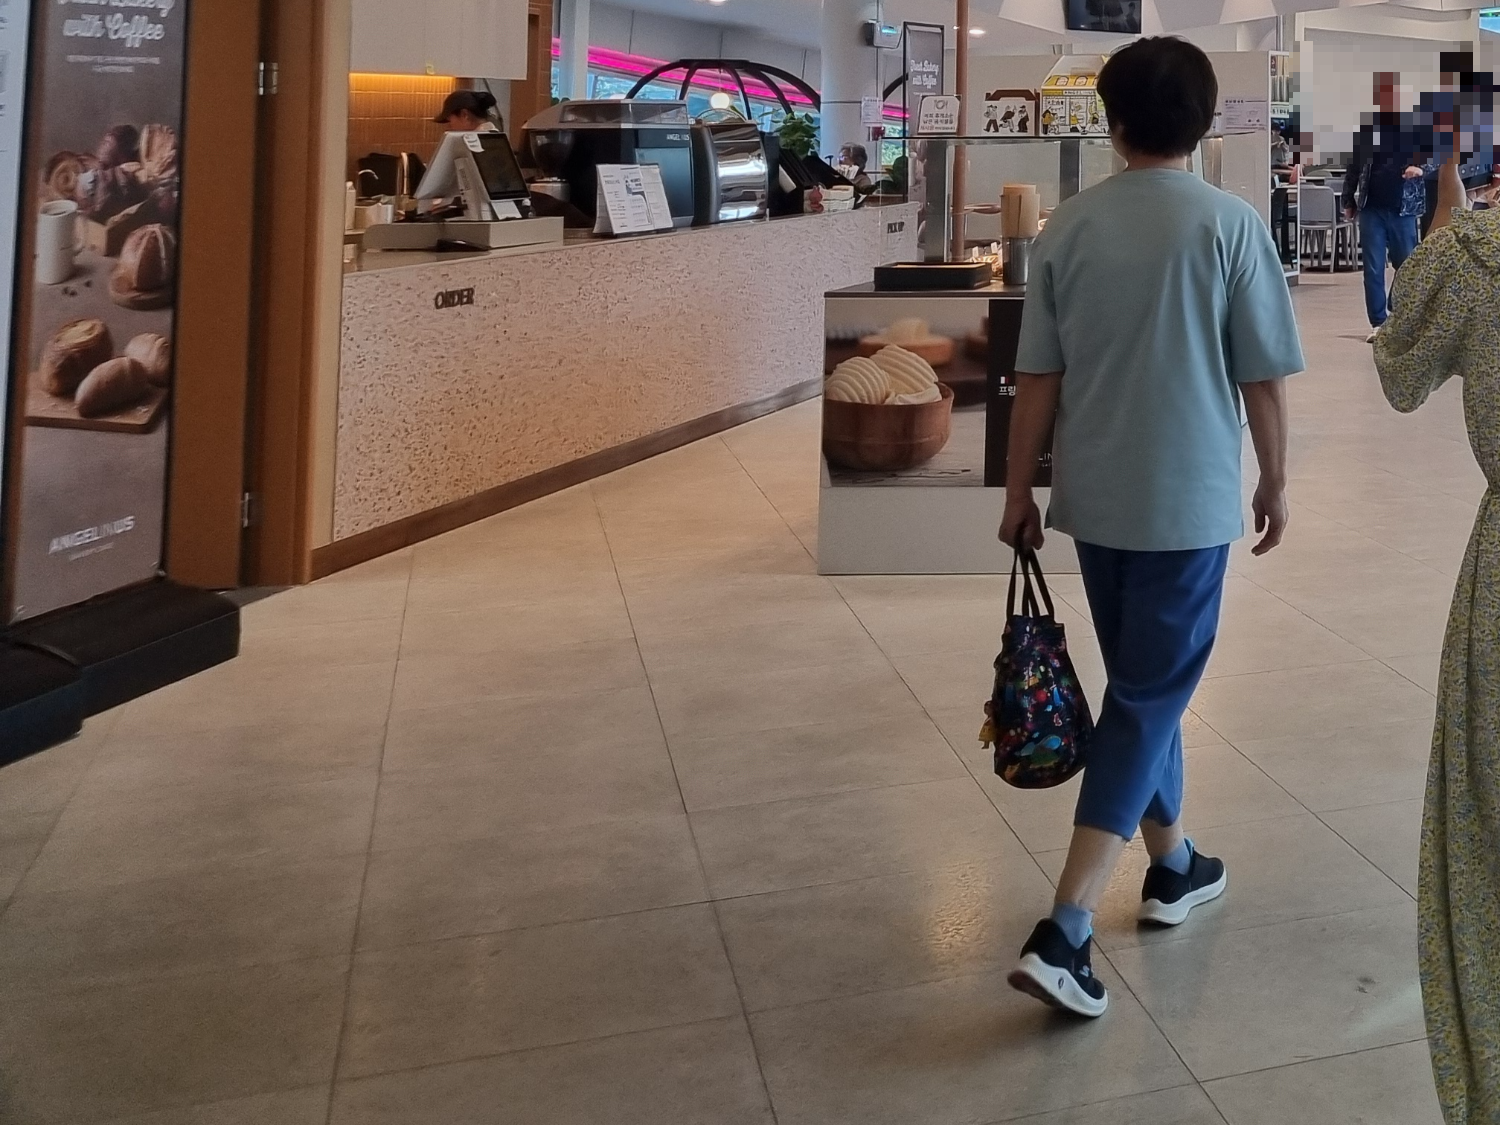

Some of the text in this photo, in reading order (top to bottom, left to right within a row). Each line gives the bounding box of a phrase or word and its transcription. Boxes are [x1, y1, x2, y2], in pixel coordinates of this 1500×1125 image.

[63, 13, 165, 47] with Coffee
[434, 287, 475, 310] ORDER
